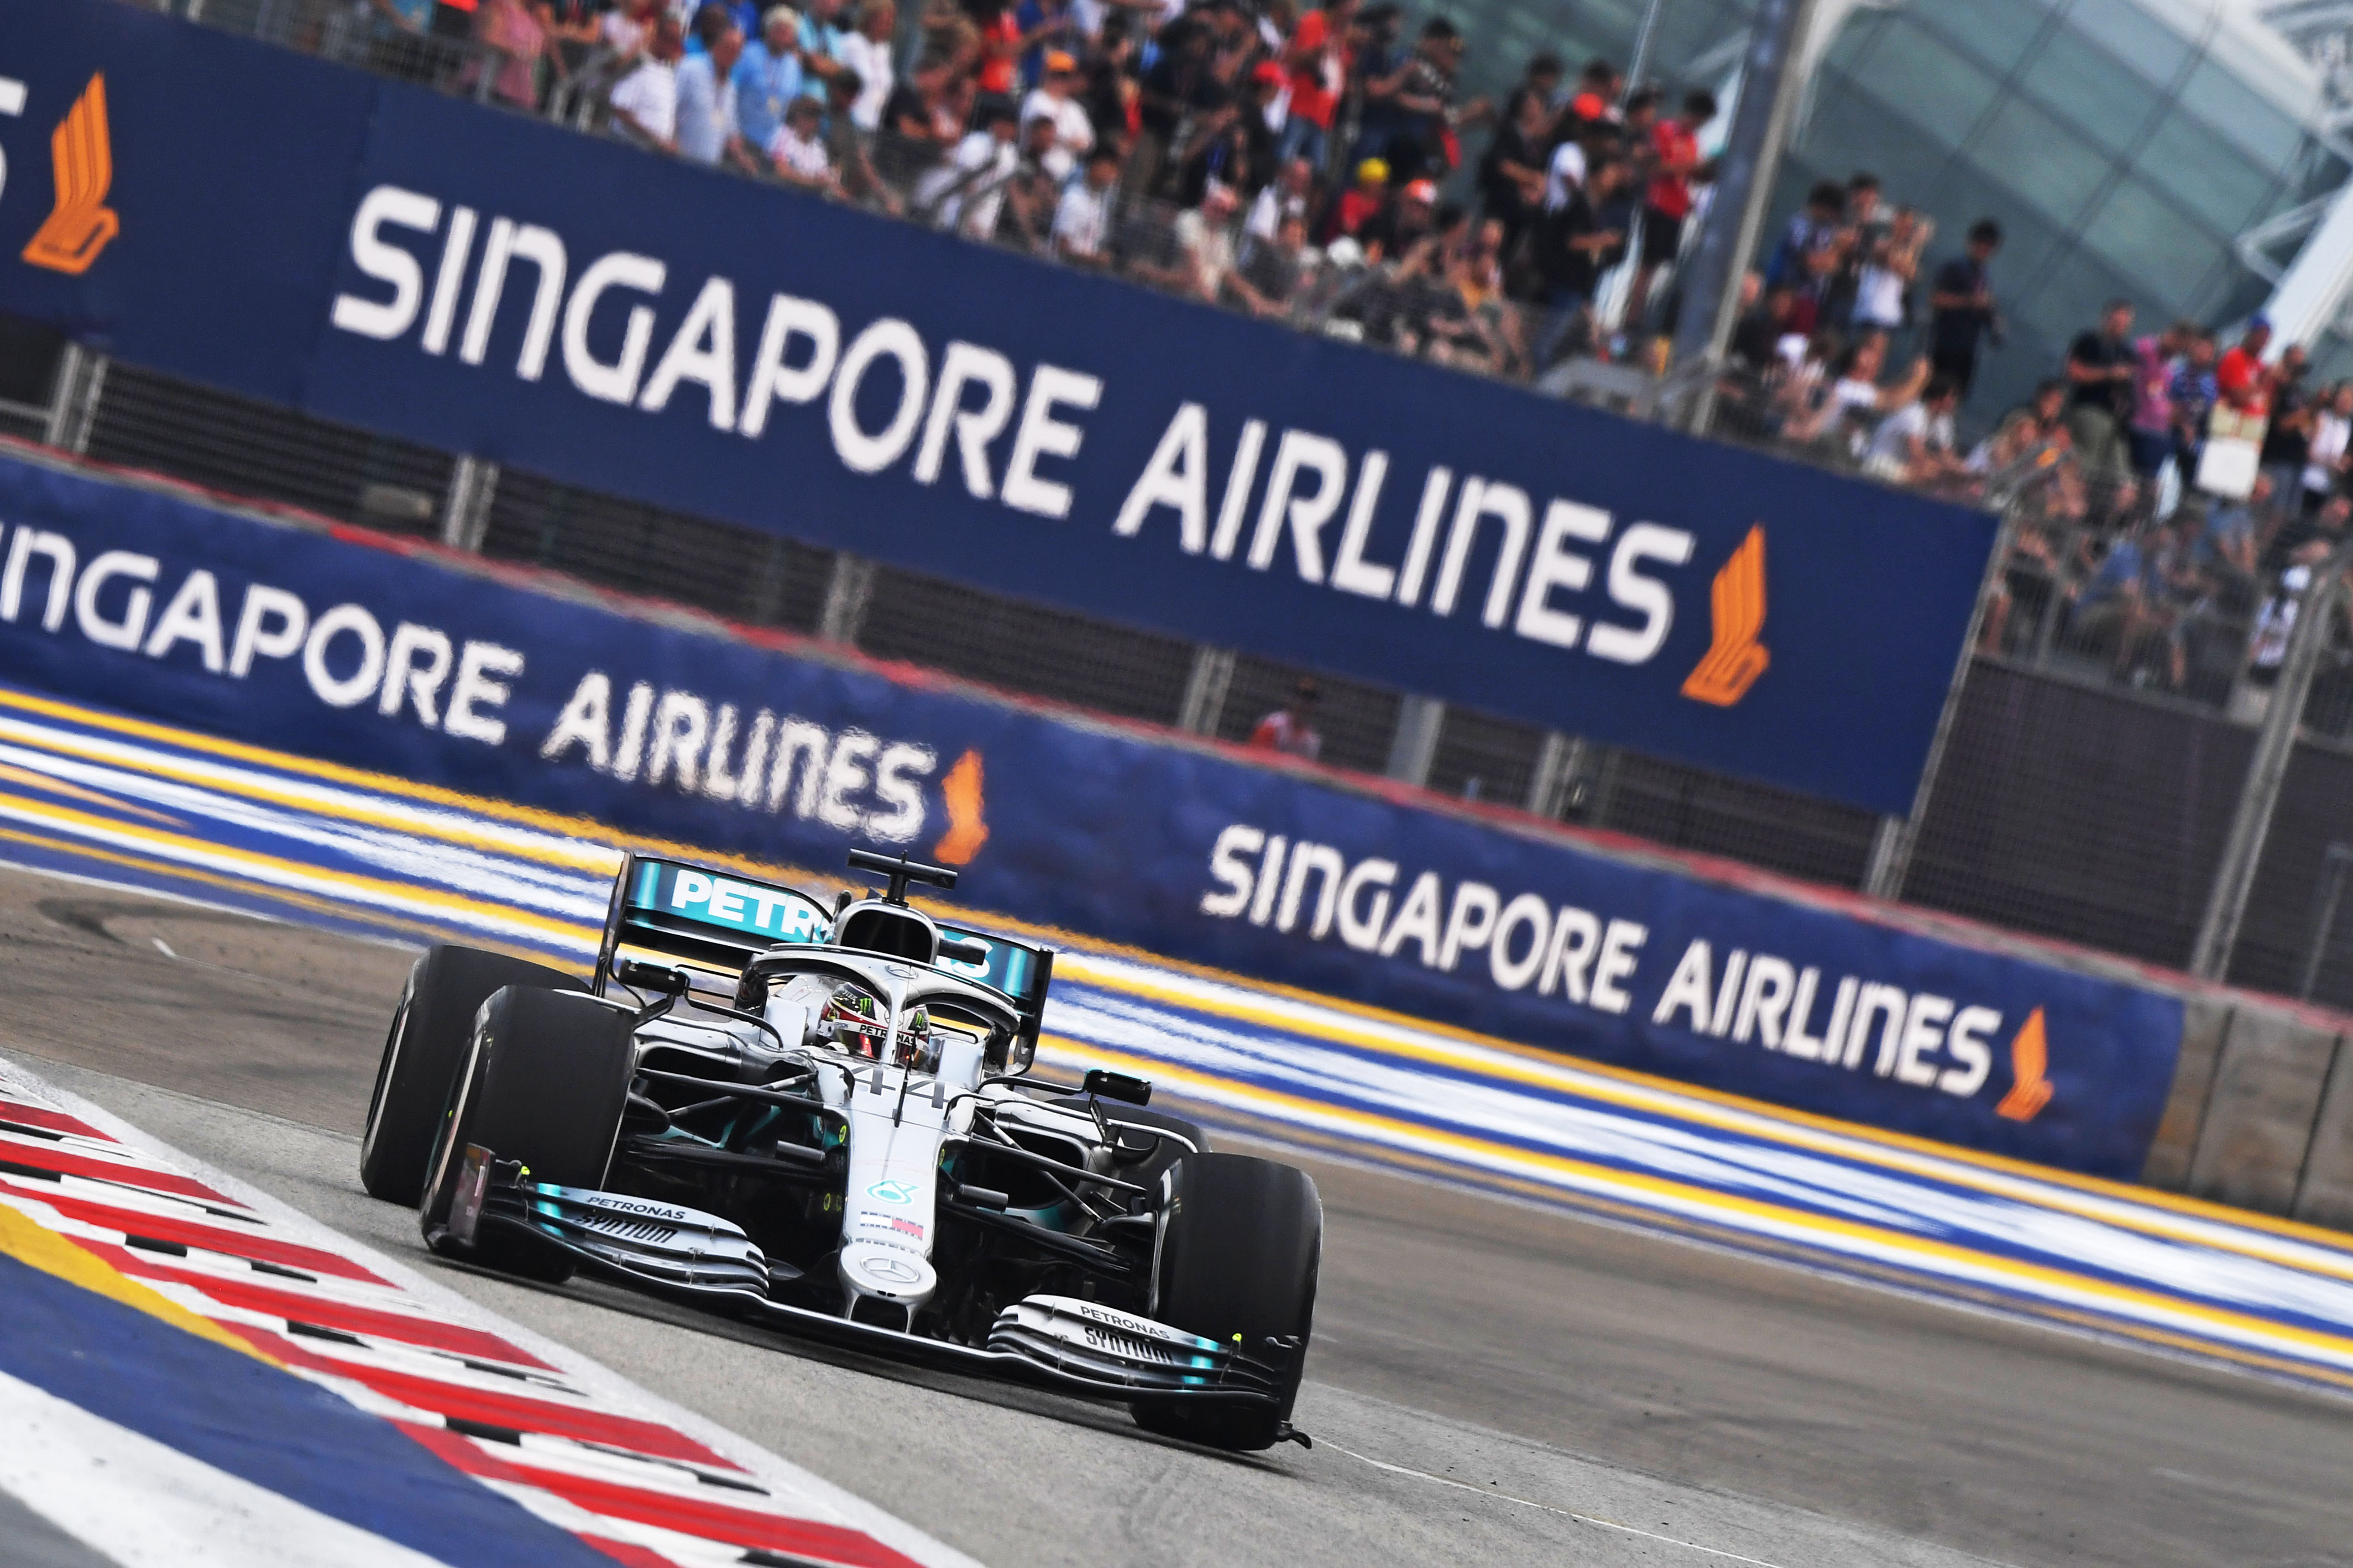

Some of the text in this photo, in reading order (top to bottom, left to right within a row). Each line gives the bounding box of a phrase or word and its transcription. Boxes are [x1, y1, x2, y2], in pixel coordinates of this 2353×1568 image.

[332, 186, 1695, 664] SINGAPORE AIRLINES
[0, 522, 937, 845] NGAPORE AIRLINES
[1200, 823, 2002, 1097] SINGAPORE AIRLINES
[859, 1024, 915, 1045] PETRNAS
[839, 1066, 950, 1110] 44
[587, 1197, 686, 1219] PETRONAS
[1080, 1305, 1170, 1339] PETRONAS
